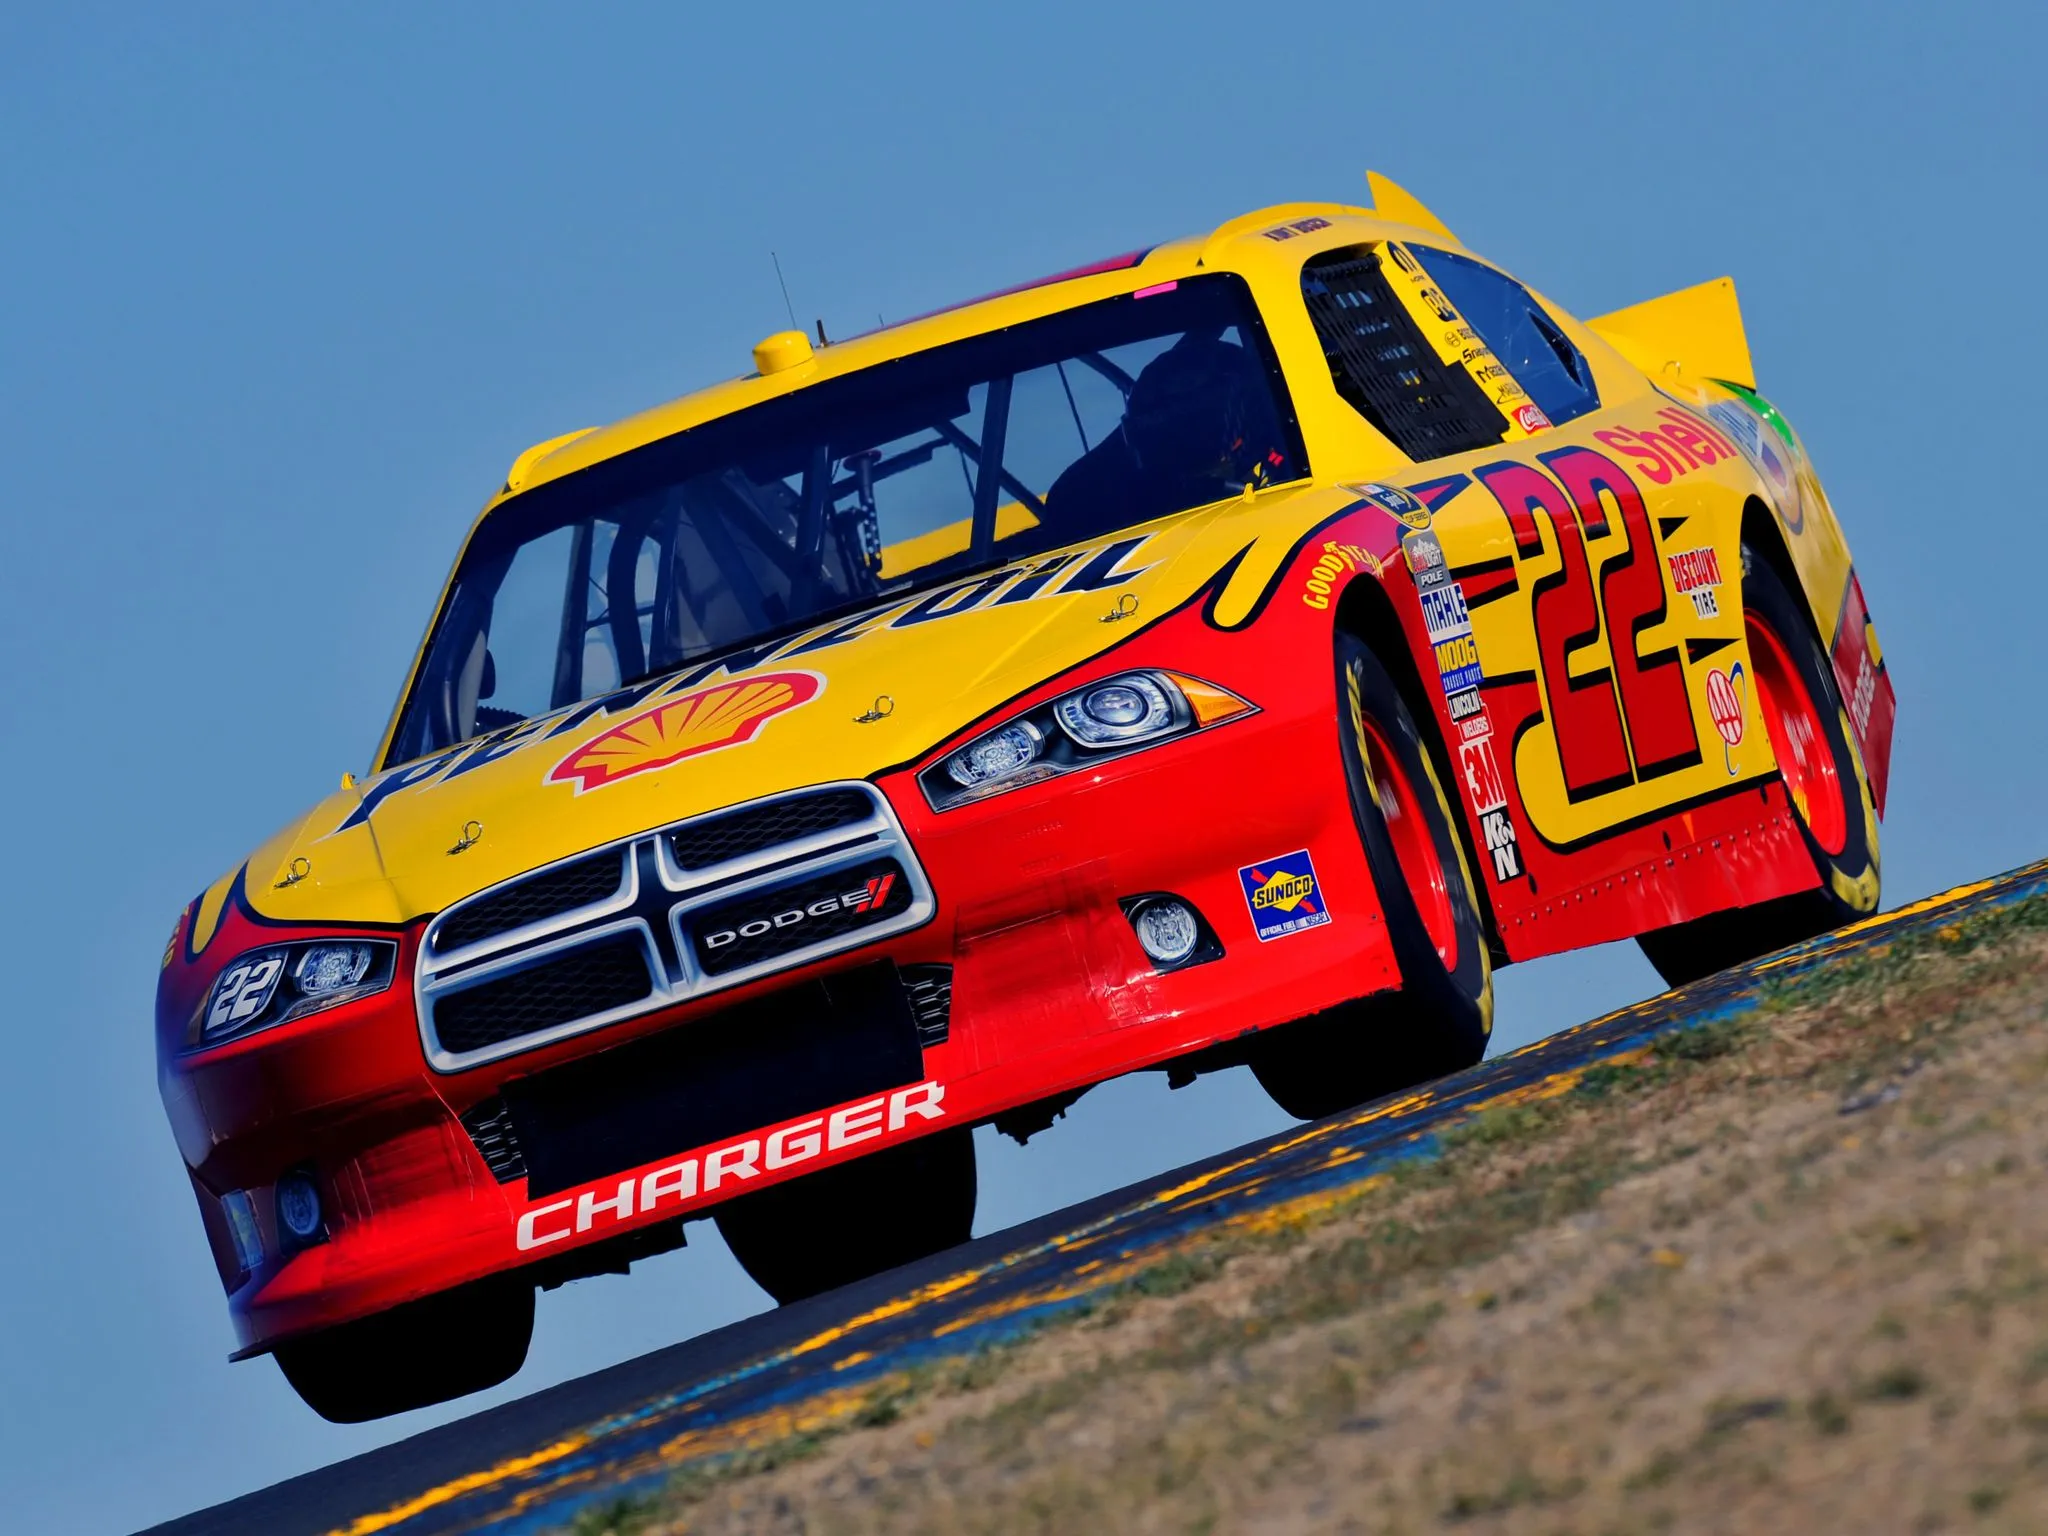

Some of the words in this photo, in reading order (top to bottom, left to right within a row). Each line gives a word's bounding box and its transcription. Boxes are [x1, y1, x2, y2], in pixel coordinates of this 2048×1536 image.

[1593, 407, 1738, 485] Shell
[1303, 541, 1384, 610] GOODYEAR
[1421, 571, 1443, 586] POLE
[1667, 547, 1722, 593] DISCOUNT
[1421, 584, 1468, 633] MAHLE
[1473, 445, 1704, 805] 22
[1692, 591, 1718, 616] TIRE
[321, 531, 1167, 841] PENNZOIL
[1435, 637, 1477, 674] MOOG
[1449, 690, 1481, 718] LINCOLN
[1464, 741, 1505, 810] 3M
[705, 888, 872, 949] DODGE
[1256, 876, 1311, 908] SUNOCO
[205, 959, 282, 1031] 22
[516, 1080, 946, 1251] CHARGER
